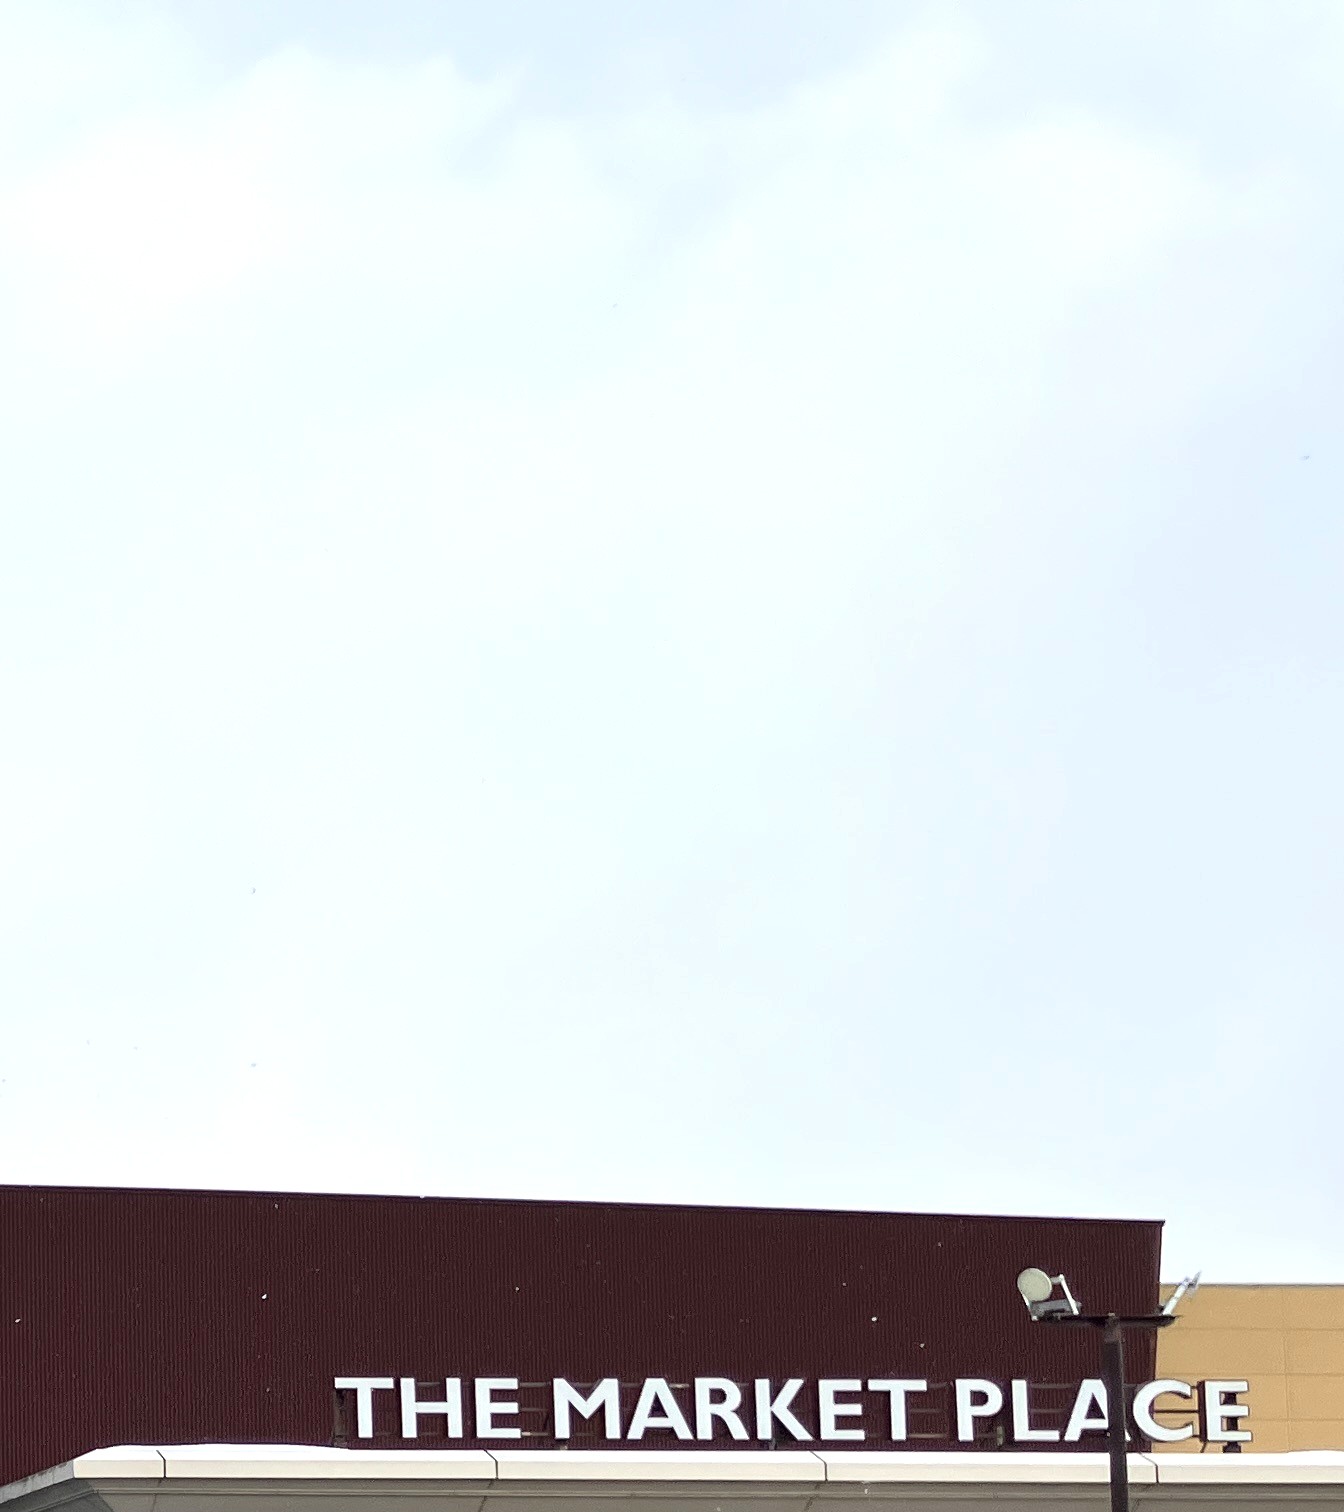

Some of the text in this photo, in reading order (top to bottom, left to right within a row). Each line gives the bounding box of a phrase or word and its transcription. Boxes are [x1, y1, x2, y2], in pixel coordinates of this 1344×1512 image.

[334, 1377, 1253, 1443] THE MARKET PLACE
